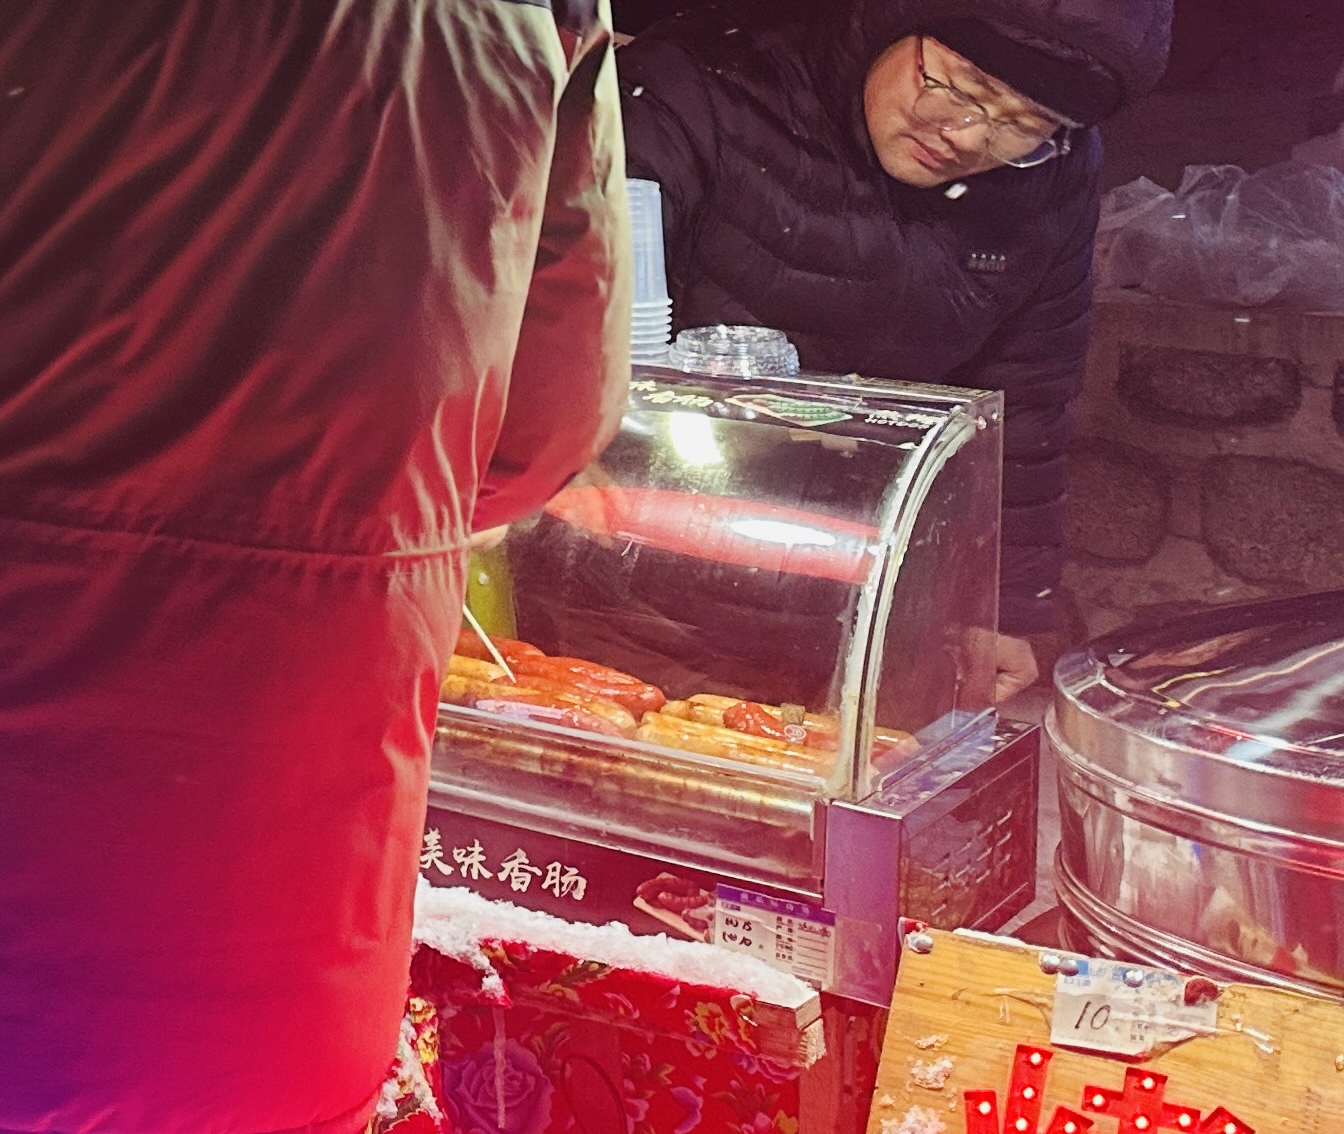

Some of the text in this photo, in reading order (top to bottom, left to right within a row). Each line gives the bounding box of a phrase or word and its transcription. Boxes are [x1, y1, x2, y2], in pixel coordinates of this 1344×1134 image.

[420, 827, 587, 901] 美味香肠
[1074, 1001, 1112, 1031] 10
